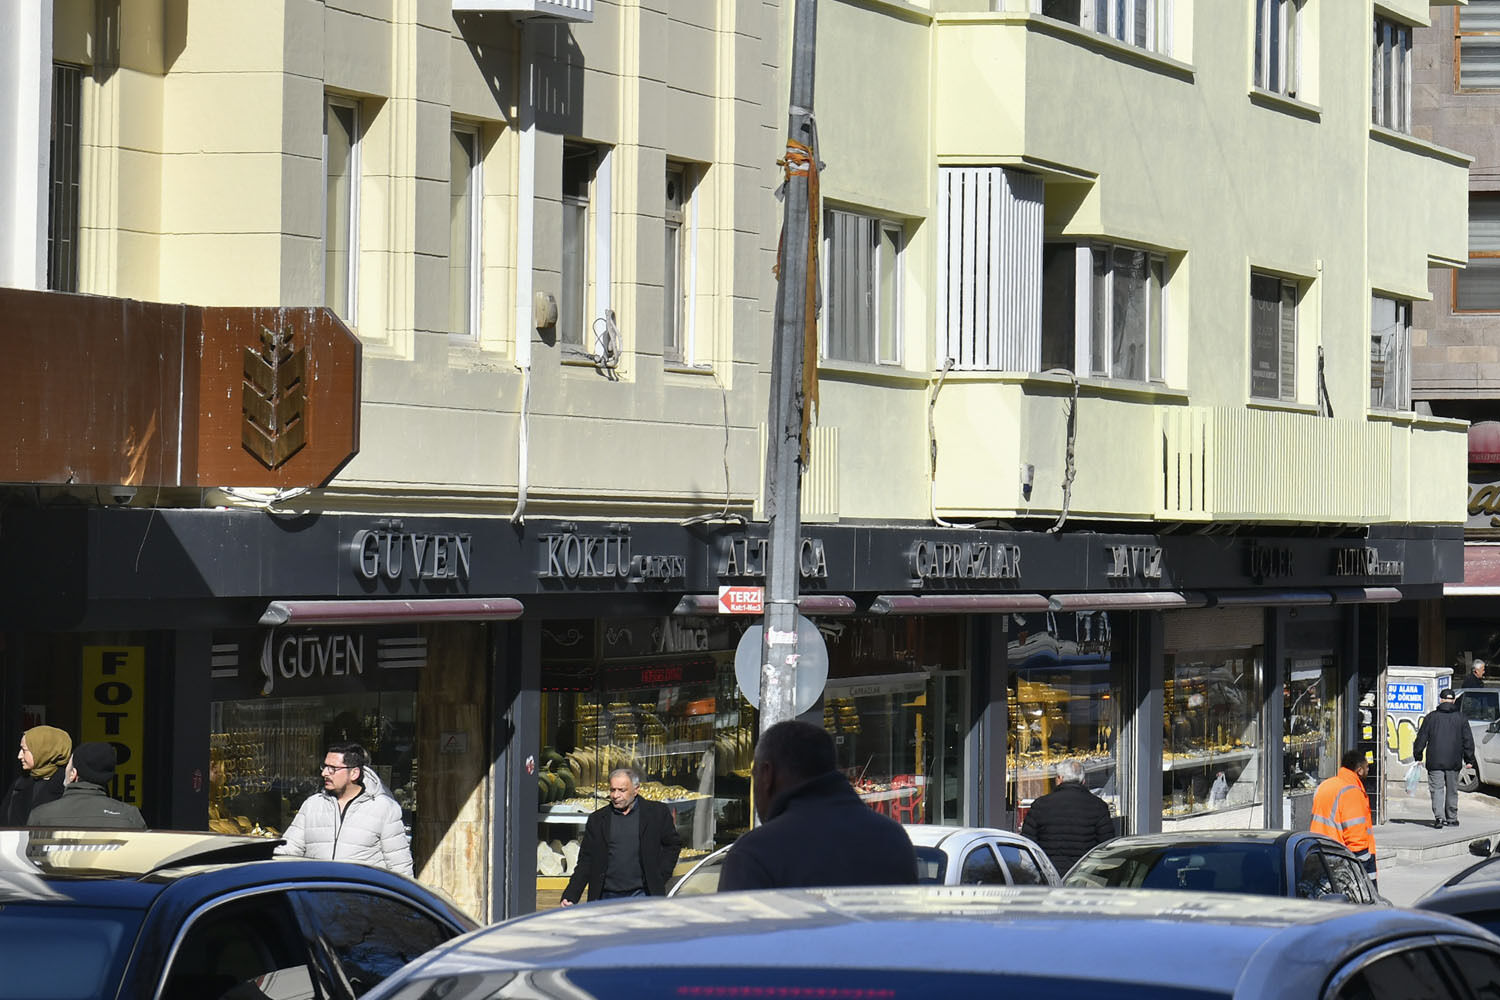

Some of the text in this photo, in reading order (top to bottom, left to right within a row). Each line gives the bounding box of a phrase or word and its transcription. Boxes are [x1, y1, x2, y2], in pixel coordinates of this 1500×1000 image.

[354, 520, 472, 579] GÜVEN
[540, 523, 687, 583] KÖKLÜ ÇARŞISI
[720, 536, 828, 577] ALTCA
[911, 540, 1022, 587] ÇAPRAZLAR
[1109, 545, 1163, 578] YAVUZ
[1336, 547, 1380, 576] ALTINCA
[728, 590, 762, 603] TERZİ
[278, 634, 364, 679] GÜVEN
[1388, 685, 1418, 693] BU ALANA
[1398, 692, 1422, 702] DÖKMEK
